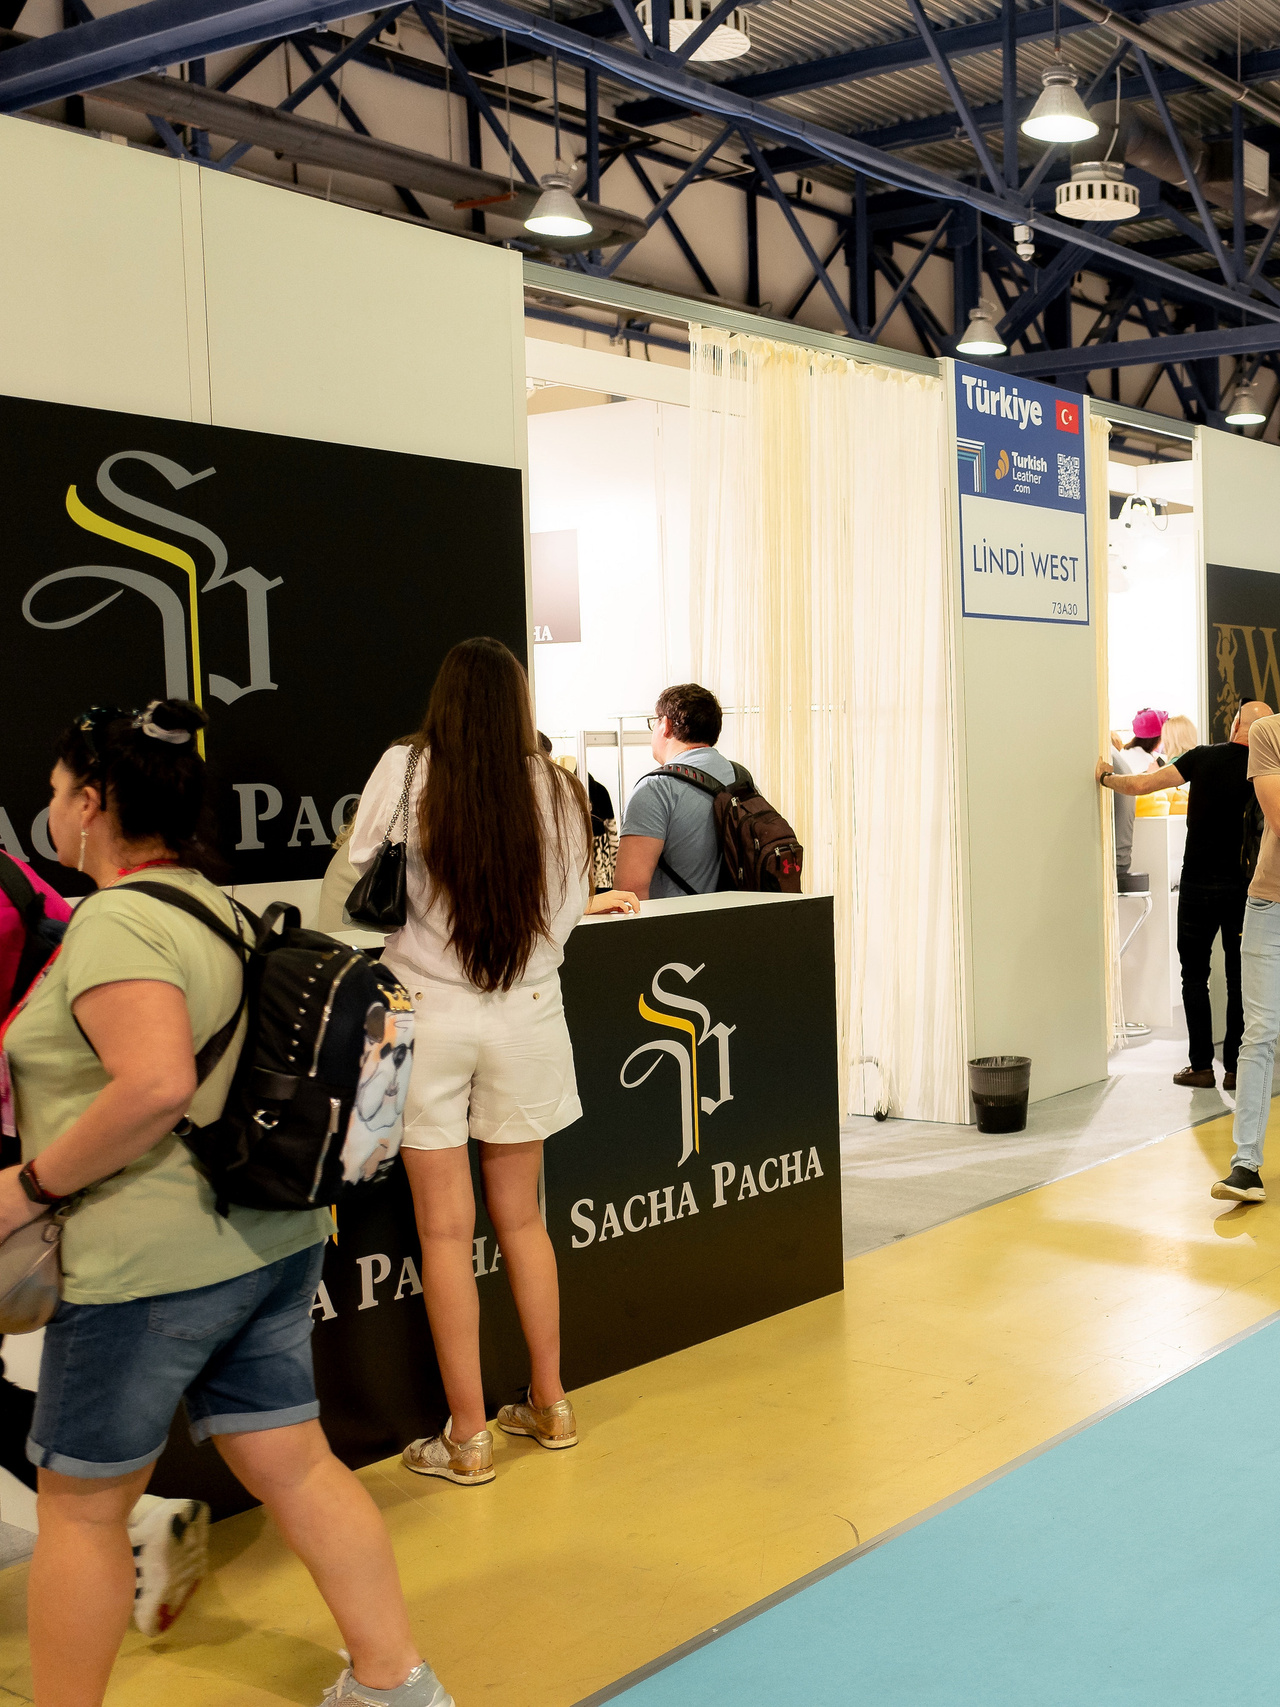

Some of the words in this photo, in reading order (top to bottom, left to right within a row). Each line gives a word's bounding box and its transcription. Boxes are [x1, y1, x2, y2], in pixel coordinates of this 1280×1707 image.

[961, 374, 1043, 430] Türkiye
[1011, 450, 1048, 473] Turkish
[1012, 467, 1042, 485] Leather
[1012, 483, 1031, 495] .com
[1031, 551, 1079, 583] WEST
[1051, 602, 1078, 616] 73A30
[570, 1181, 700, 1249] SACHA
[711, 1146, 824, 1208] PACHA
